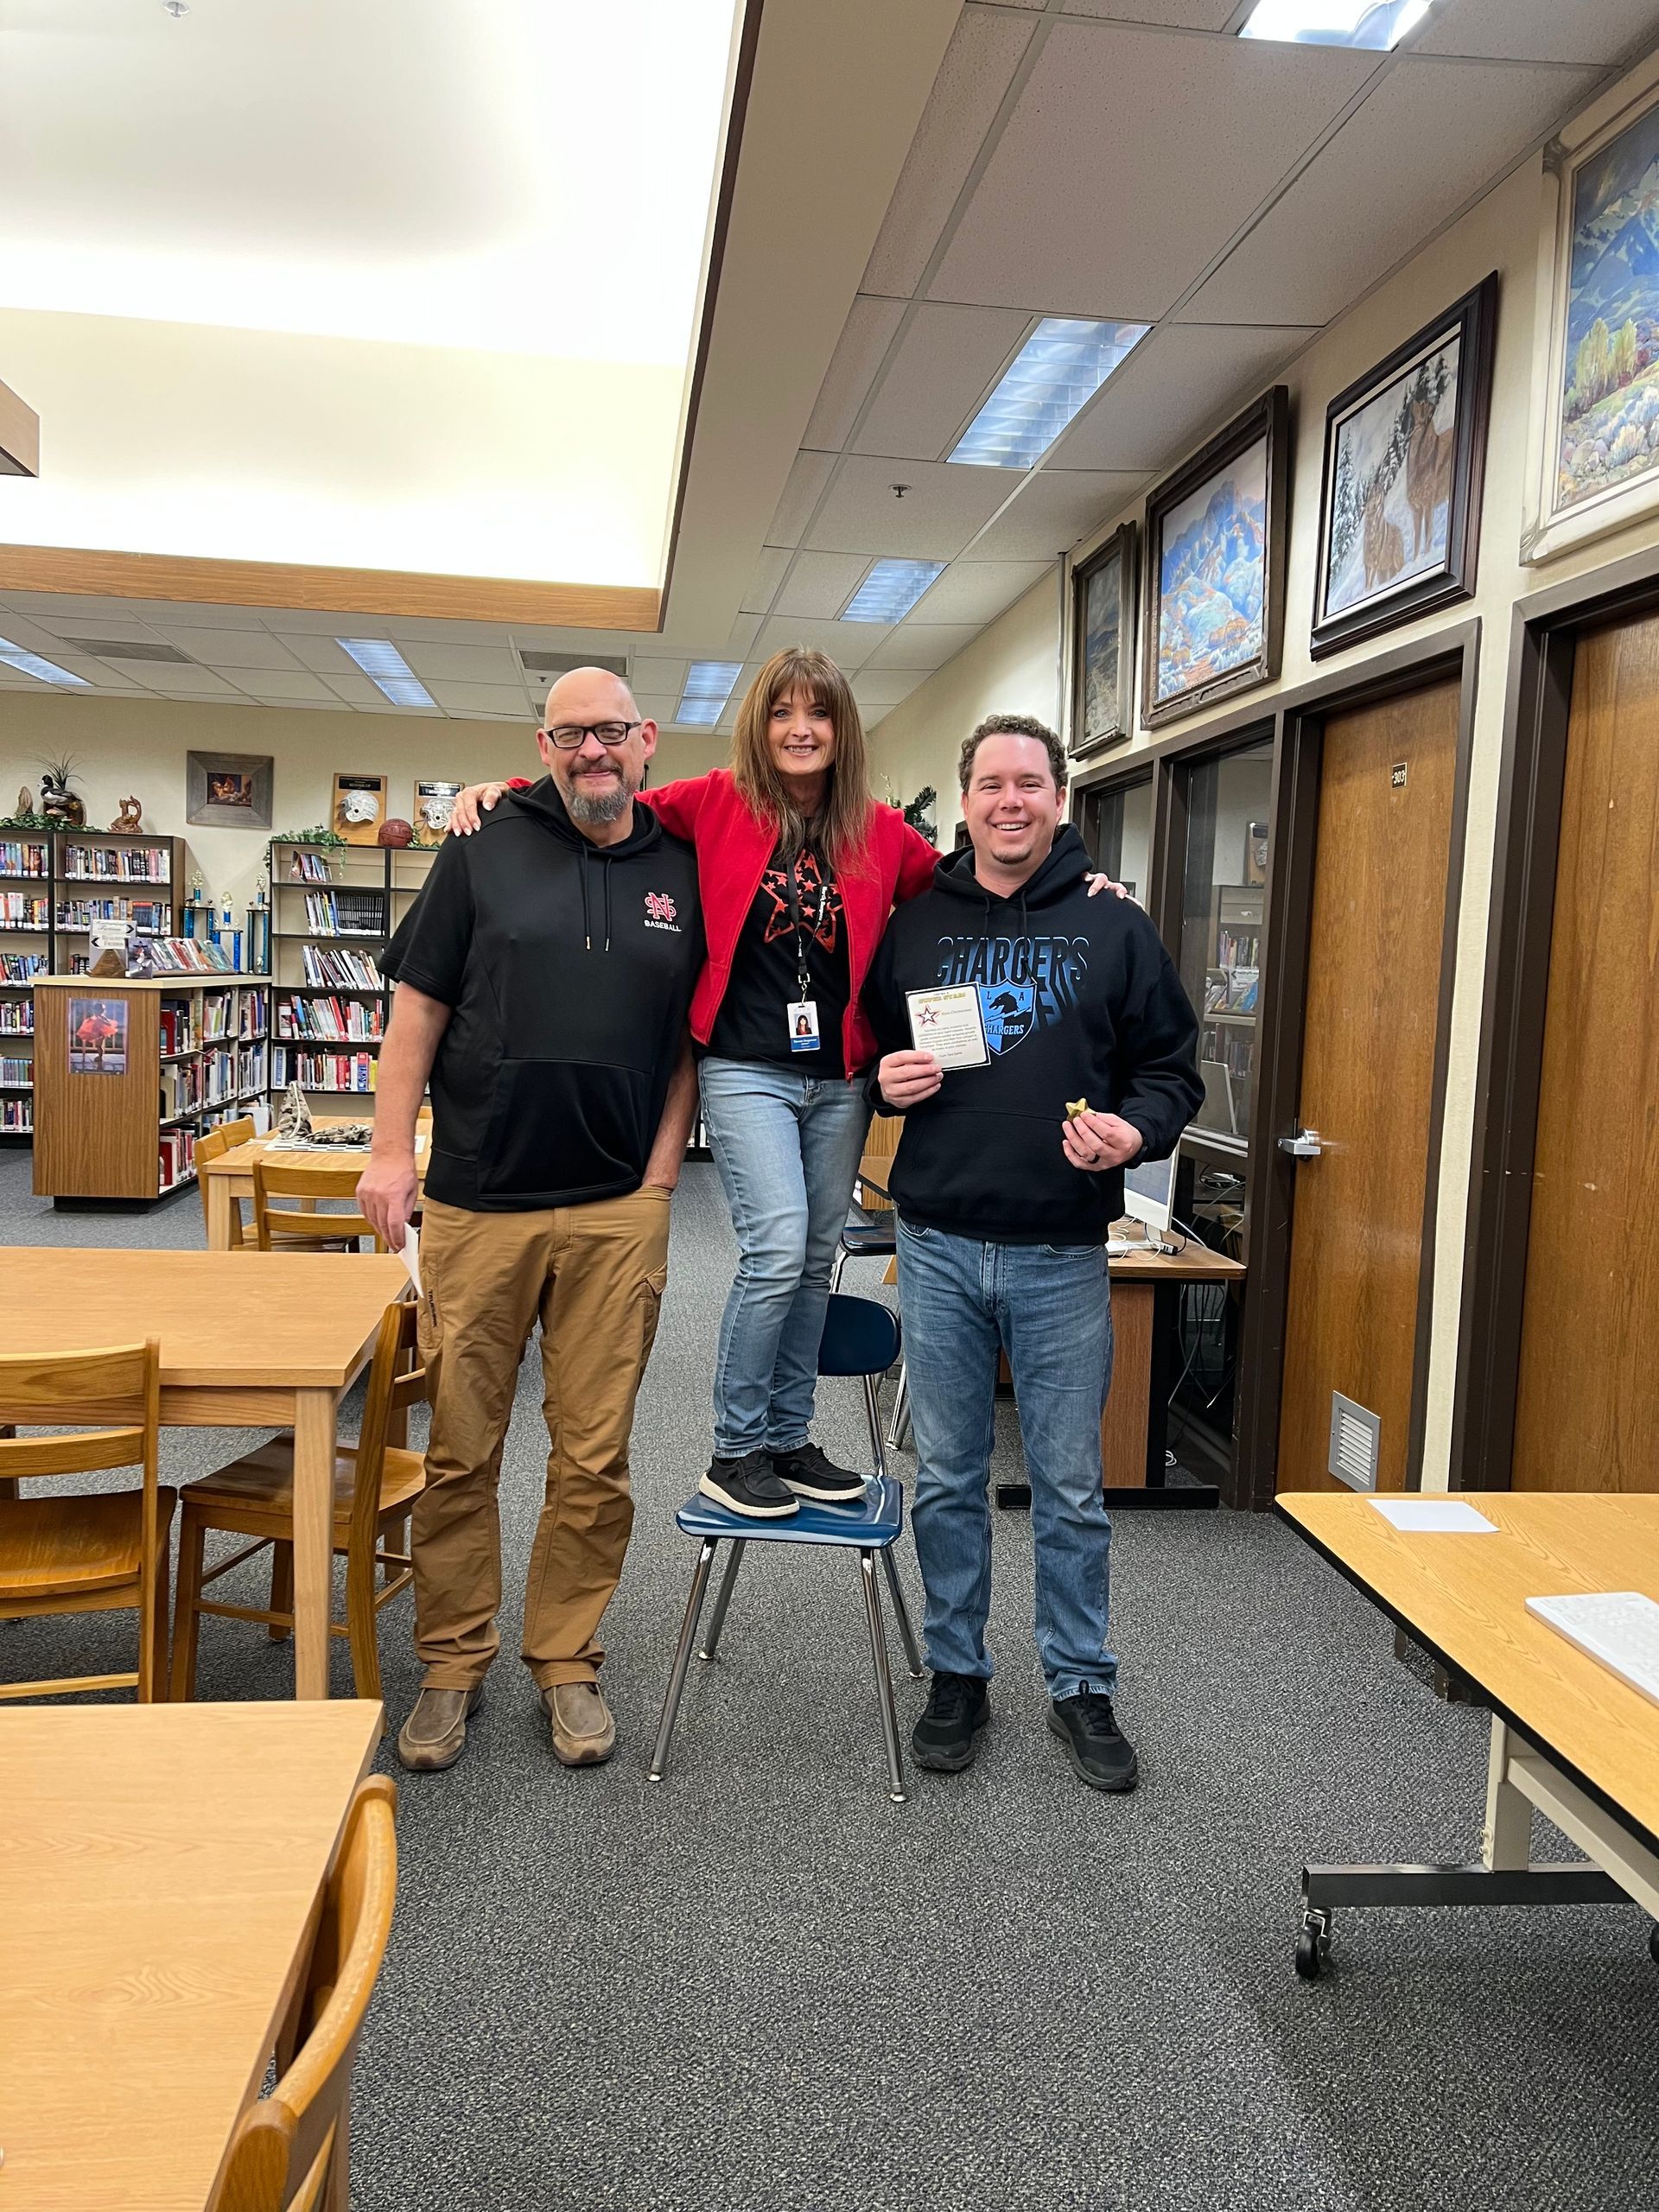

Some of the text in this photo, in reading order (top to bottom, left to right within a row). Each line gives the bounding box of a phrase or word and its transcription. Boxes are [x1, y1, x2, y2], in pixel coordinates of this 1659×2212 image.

[644, 919, 682, 932] BASEBALL
[938, 937, 1090, 984] CHARGERS
[986, 991, 1025, 1001] L A
